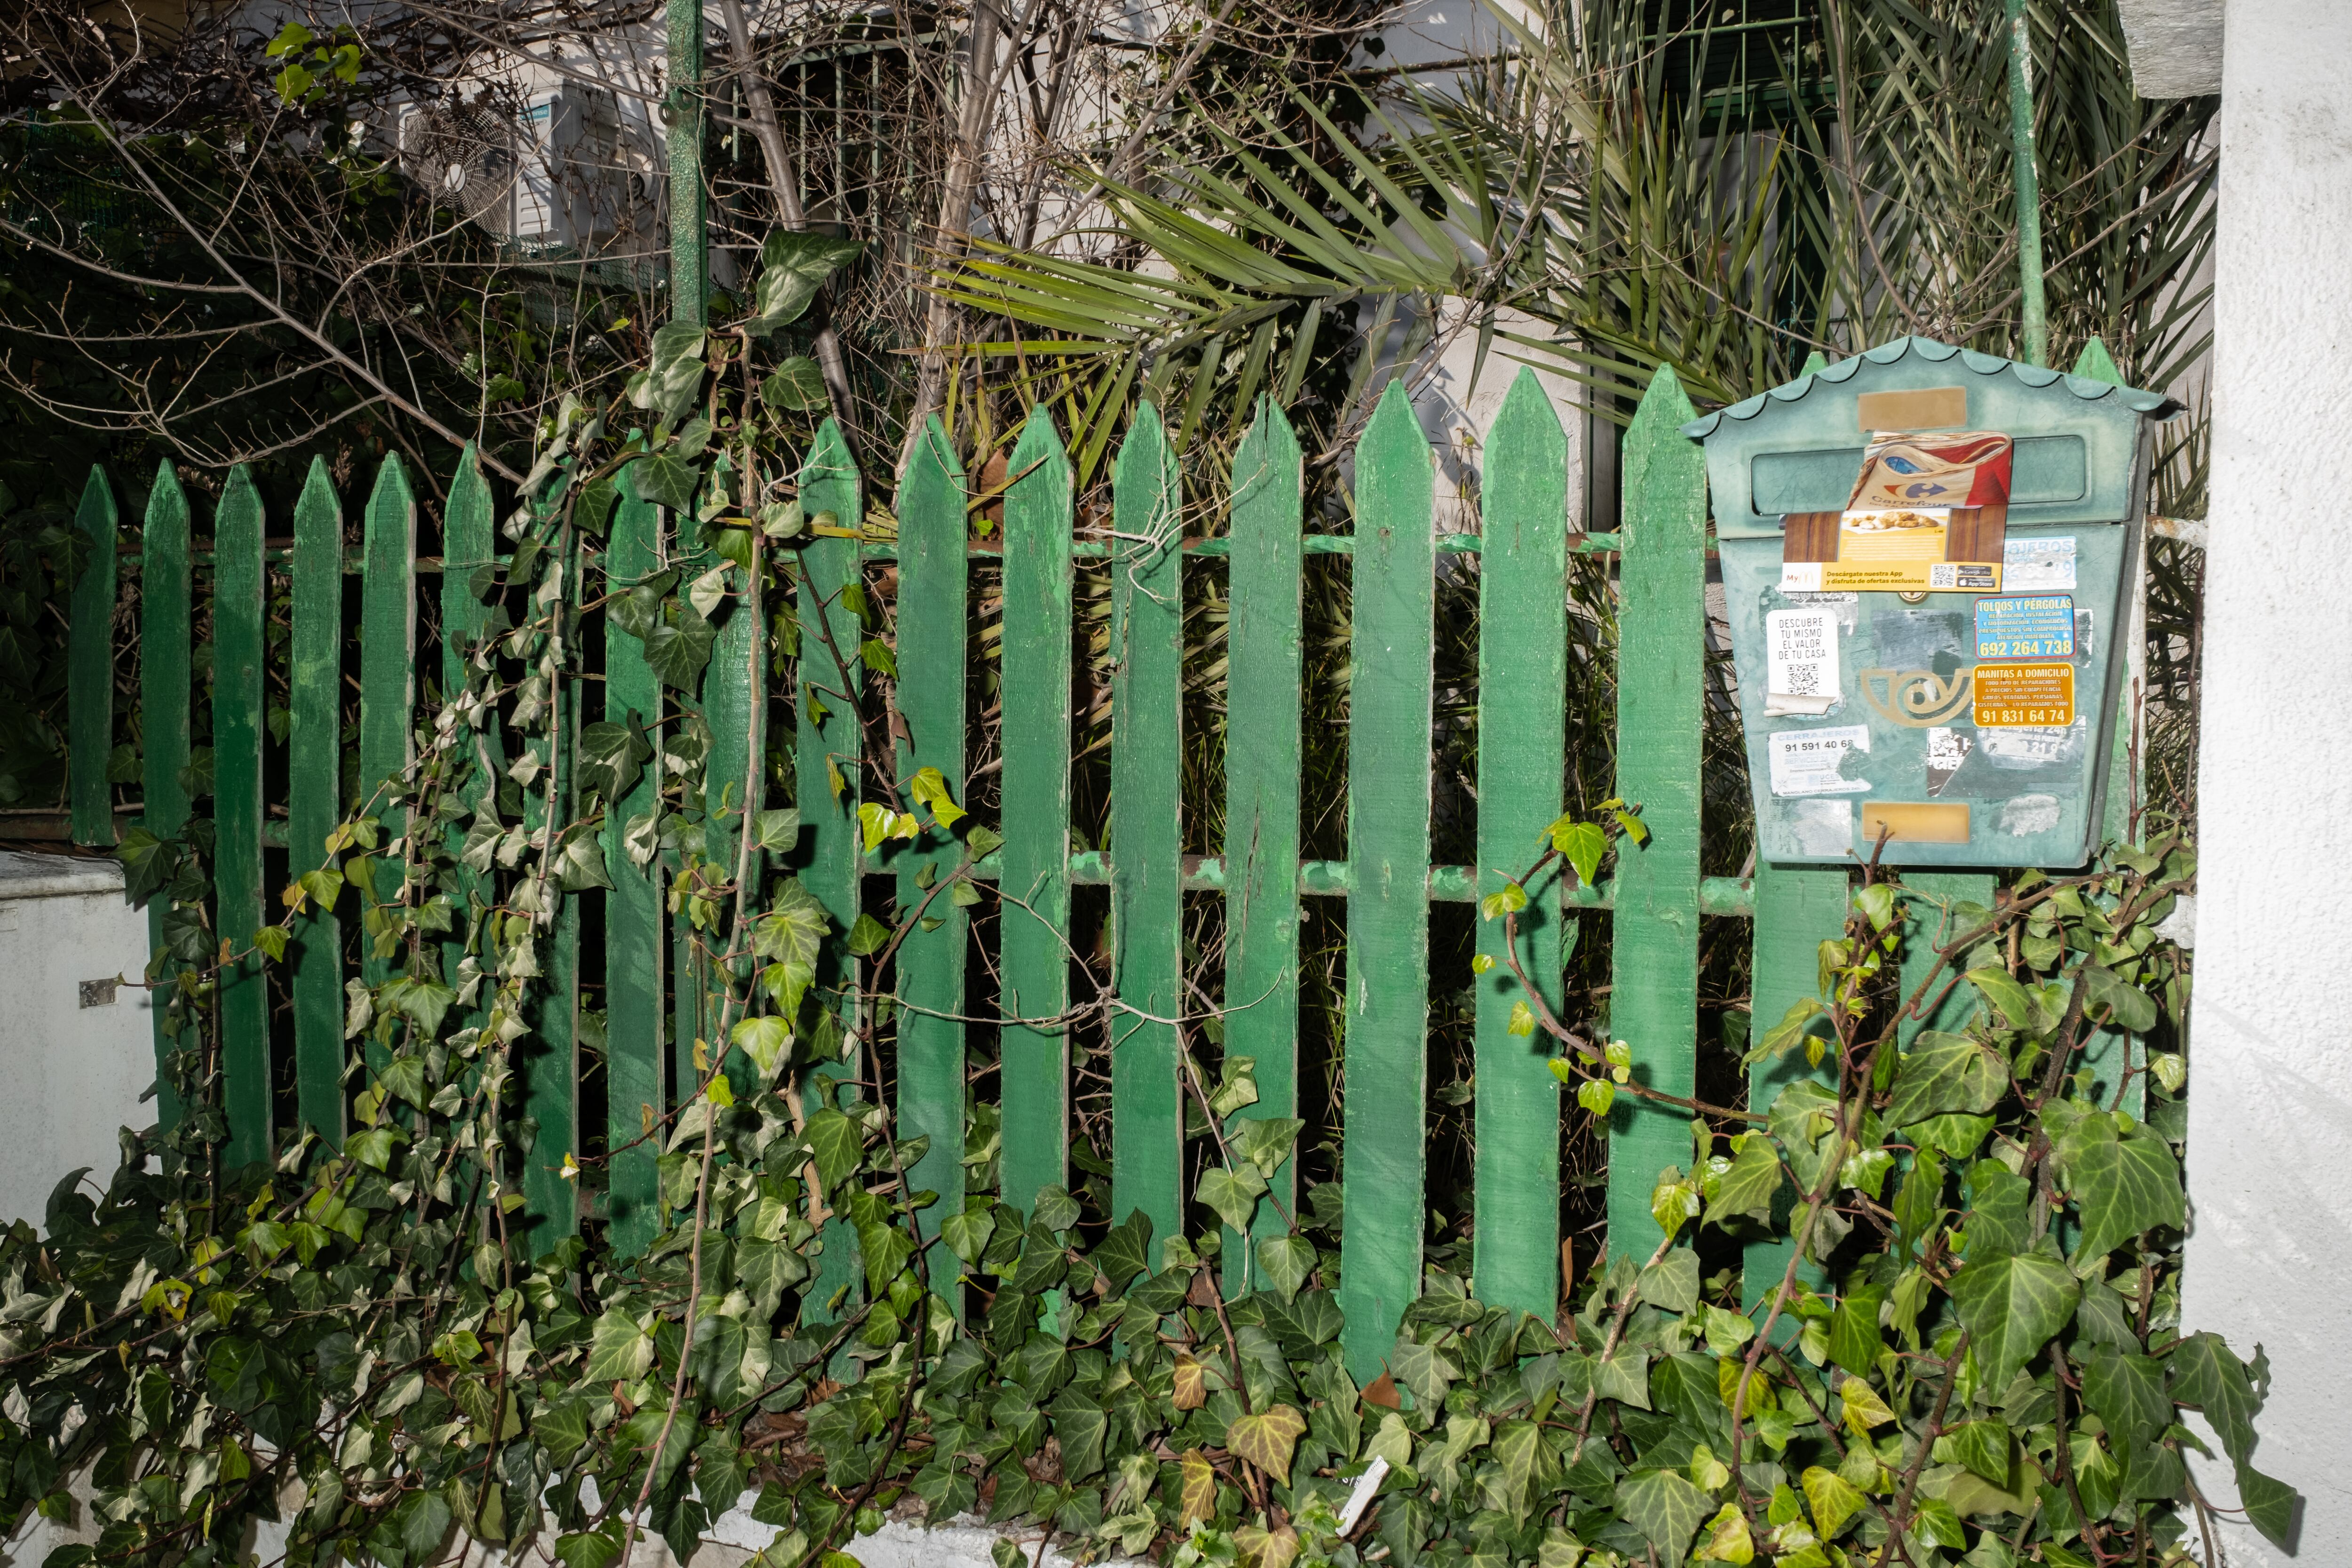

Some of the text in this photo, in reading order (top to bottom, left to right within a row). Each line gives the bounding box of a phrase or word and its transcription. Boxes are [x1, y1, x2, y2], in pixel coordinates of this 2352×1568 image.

[1871, 495, 1951, 507] Carrefour
[1978, 597, 2072, 612] TOLDOS Y PÉRGOLAS
[1779, 617, 1823, 629] DESCUBRE
[1781, 629, 1821, 639] TU MISMO
[1783, 639, 1820, 649] EL VALOR
[1979, 640, 2072, 656] 692 264 738
[1779, 649, 1826, 660] DE TU CASA
[1977, 668, 2069, 678] MANITAS A DOMICILIO
[1982, 709, 2065, 723] 91 831 64 74
[1778, 729, 1859, 741] CERRAJEROS
[1802, 742, 1820, 751] 591
